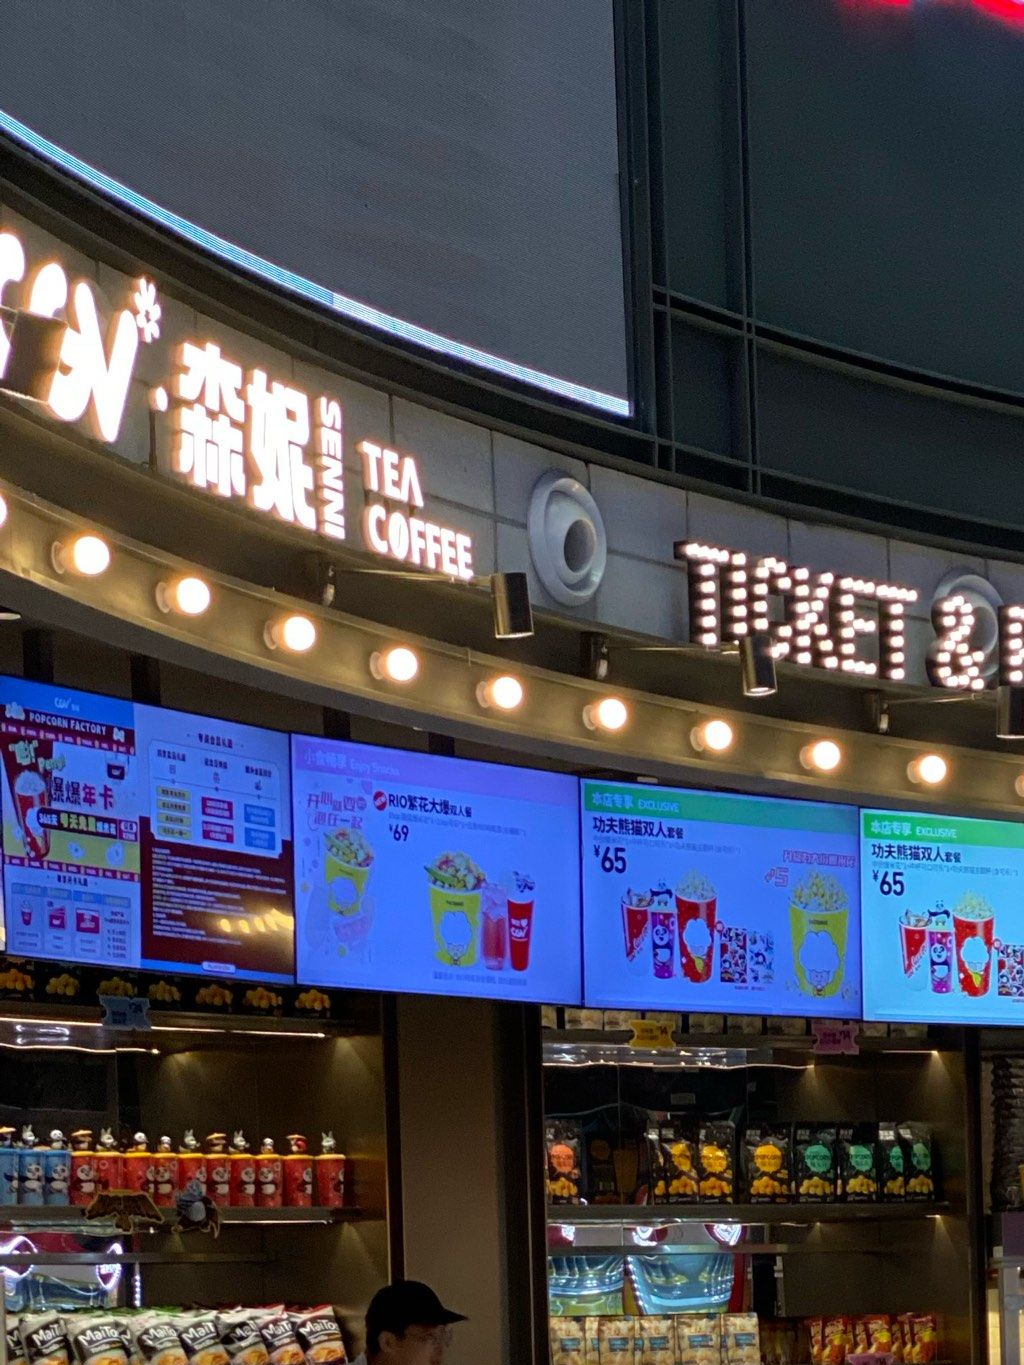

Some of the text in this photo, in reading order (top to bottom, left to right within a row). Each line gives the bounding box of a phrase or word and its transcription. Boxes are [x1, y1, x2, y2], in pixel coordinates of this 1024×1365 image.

[318, 396, 346, 540] SENNI
[360, 440, 424, 508] TEA
[367, 504, 474, 580] COFFEE
[674, 541, 917, 682] TICKET
[926, 593, 986, 691] &
[29, 711, 68, 729] POPCORN
[70, 720, 106, 736] FACTORY
[637, 798, 680, 812] EXCLUSIVE
[592, 816, 684, 839] 功夫熊猫双人套餐
[915, 826, 957, 839] EXCLUSIVE
[593, 843, 627, 874] ¥65
[871, 843, 962, 863] 功夫熊猫双人套餐
[872, 869, 905, 897] ¥65
